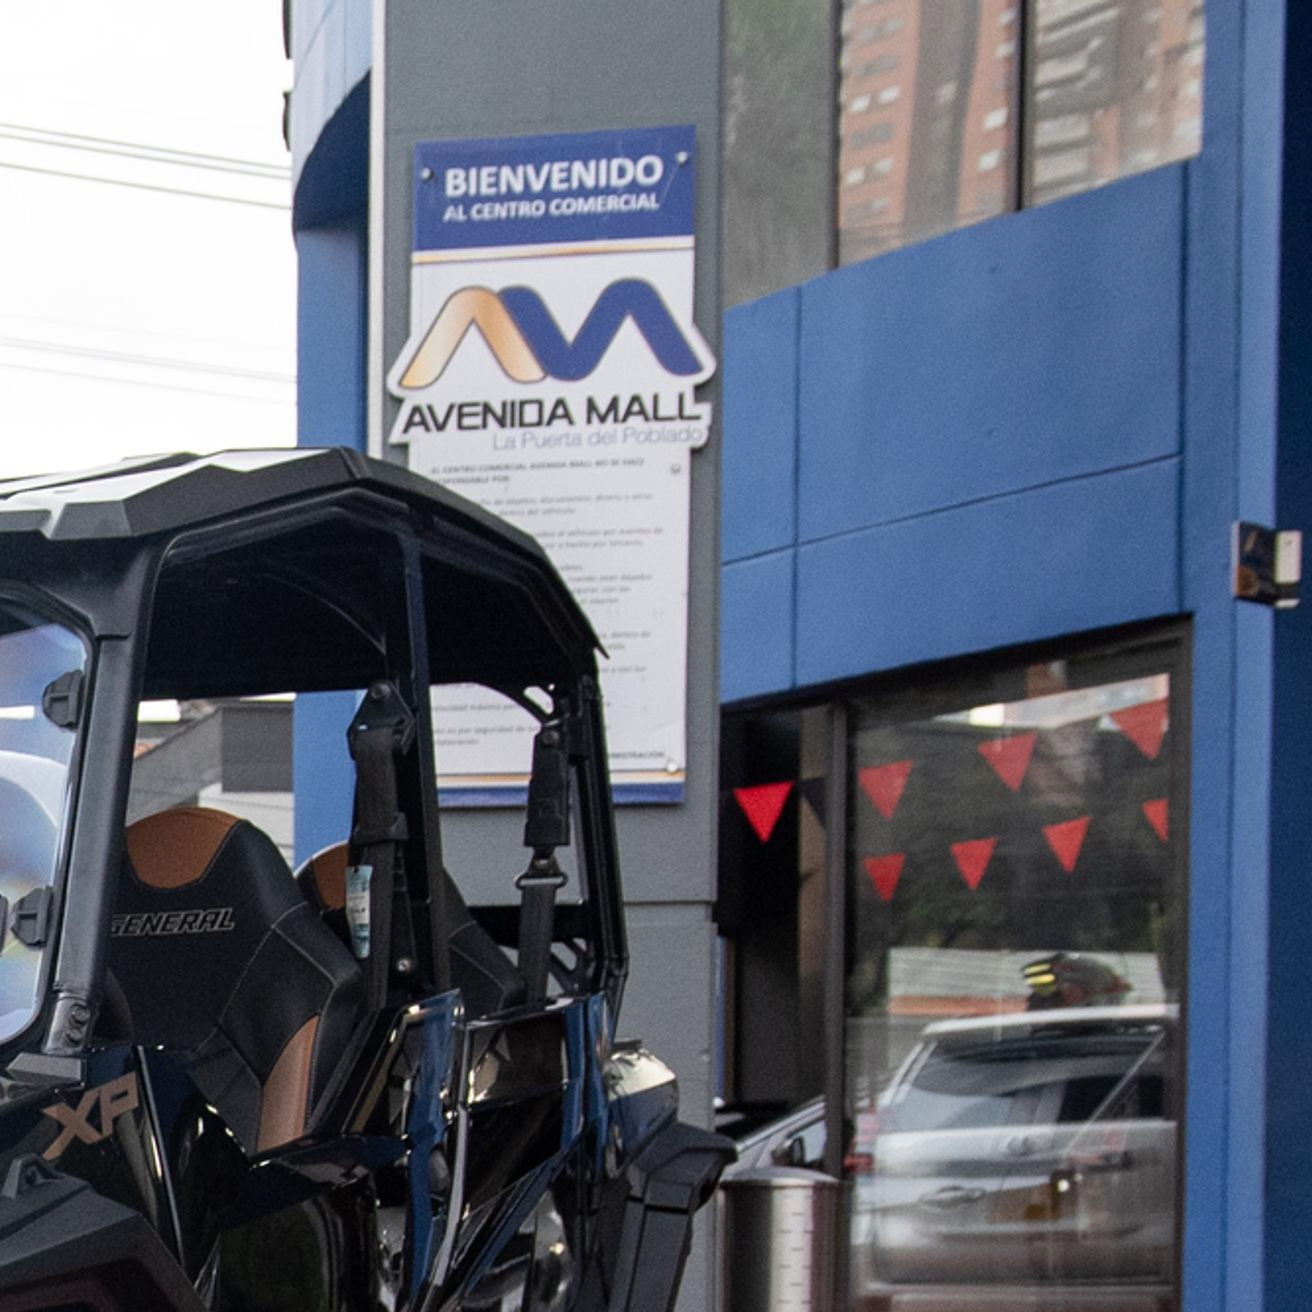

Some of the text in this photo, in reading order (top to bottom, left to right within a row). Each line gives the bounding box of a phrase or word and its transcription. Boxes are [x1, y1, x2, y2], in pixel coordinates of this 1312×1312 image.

[444, 154, 664, 198] BIENVENIDO
[442, 192, 660, 223] AL CENTRO COMERCIAL
[402, 392, 702, 434] AVENIDA MALL
[492, 424, 704, 451] La Puerta del Poblado
[42, 1070, 138, 1160] XP
